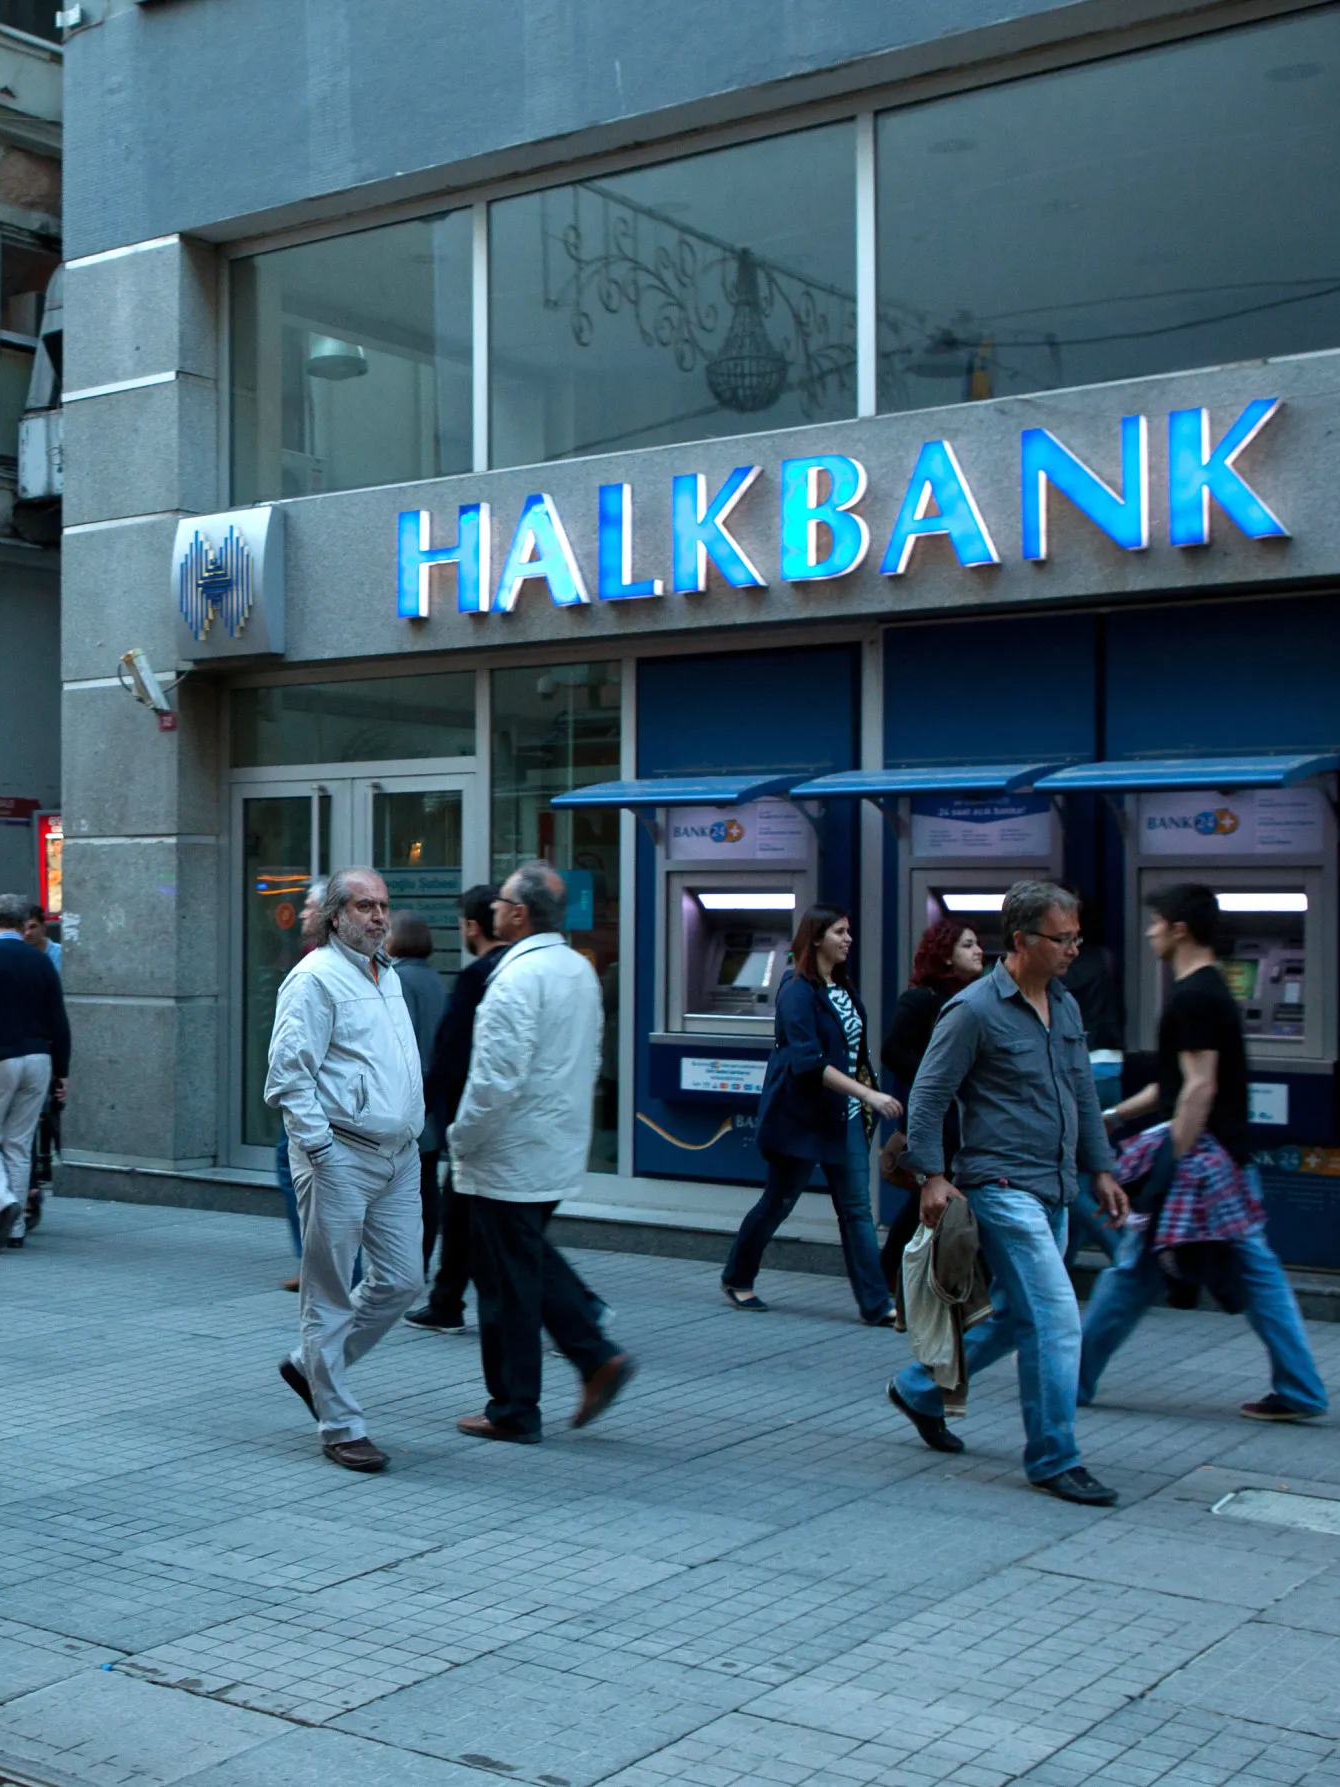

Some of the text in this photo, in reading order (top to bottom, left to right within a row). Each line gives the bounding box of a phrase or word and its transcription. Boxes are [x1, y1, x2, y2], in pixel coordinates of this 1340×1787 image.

[396, 396, 1292, 620] HALKBANK
[1146, 816, 1193, 830] BANK
[673, 825, 710, 838] BANK
